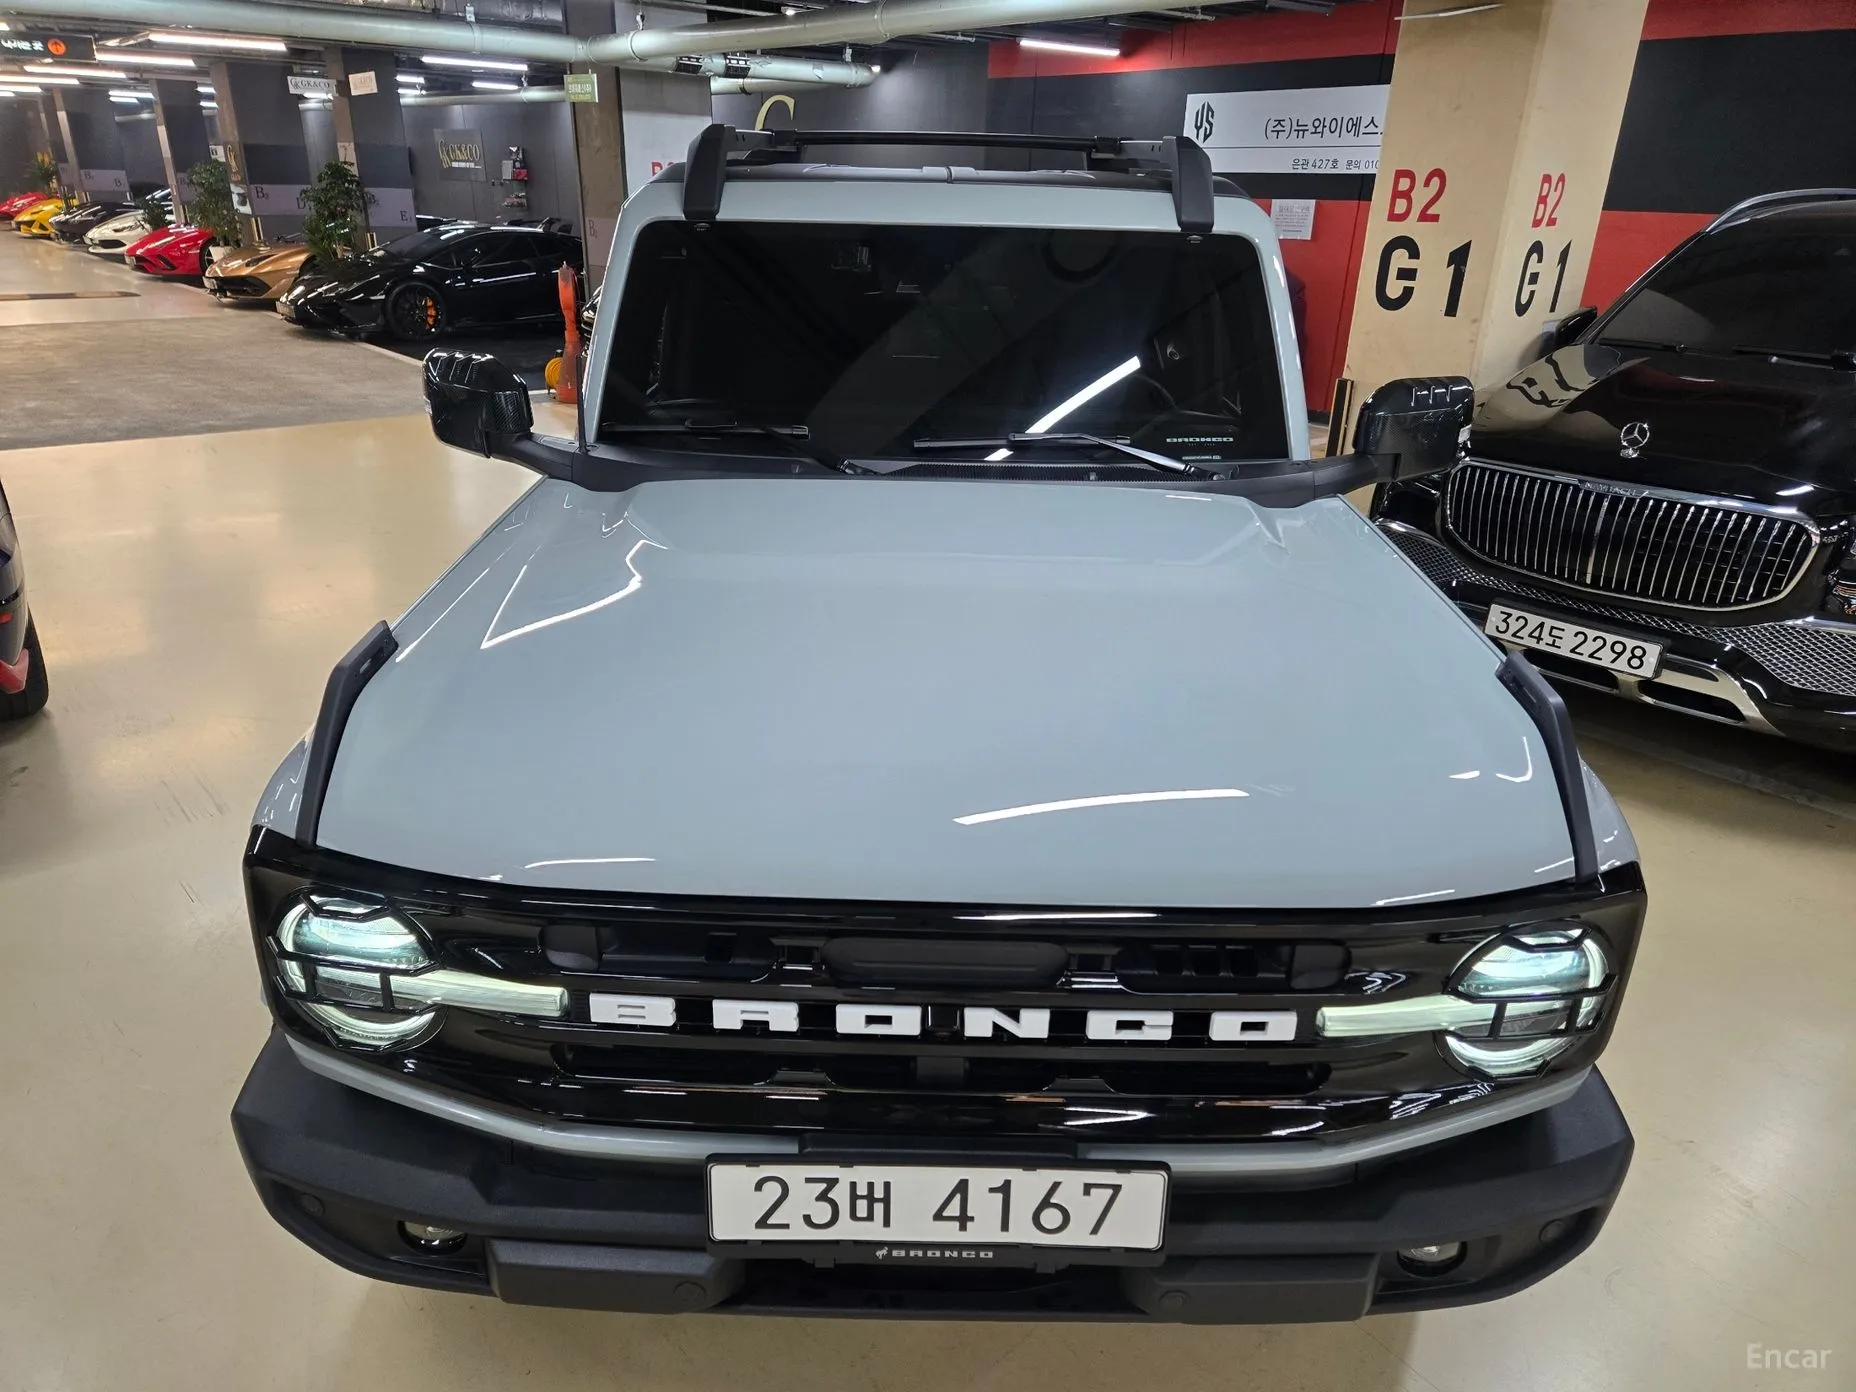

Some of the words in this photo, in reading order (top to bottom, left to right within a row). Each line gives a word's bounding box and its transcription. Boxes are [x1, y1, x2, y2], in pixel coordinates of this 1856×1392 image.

[1264, 116, 1383, 140] (주)뉴와이에스
[1312, 159, 1339, 170] 427호
[1345, 159, 1362, 170] 문의
[1386, 168, 1447, 223] B2
[1531, 173, 1566, 229] B2
[1495, 611, 1565, 649] 324도
[1569, 631, 1647, 670] 2298
[589, 993, 1298, 1041] BRONCO
[753, 1175, 892, 1230] 23버
[932, 1178, 1123, 1236] 4167
[892, 1249, 993, 1259] BRONCO
